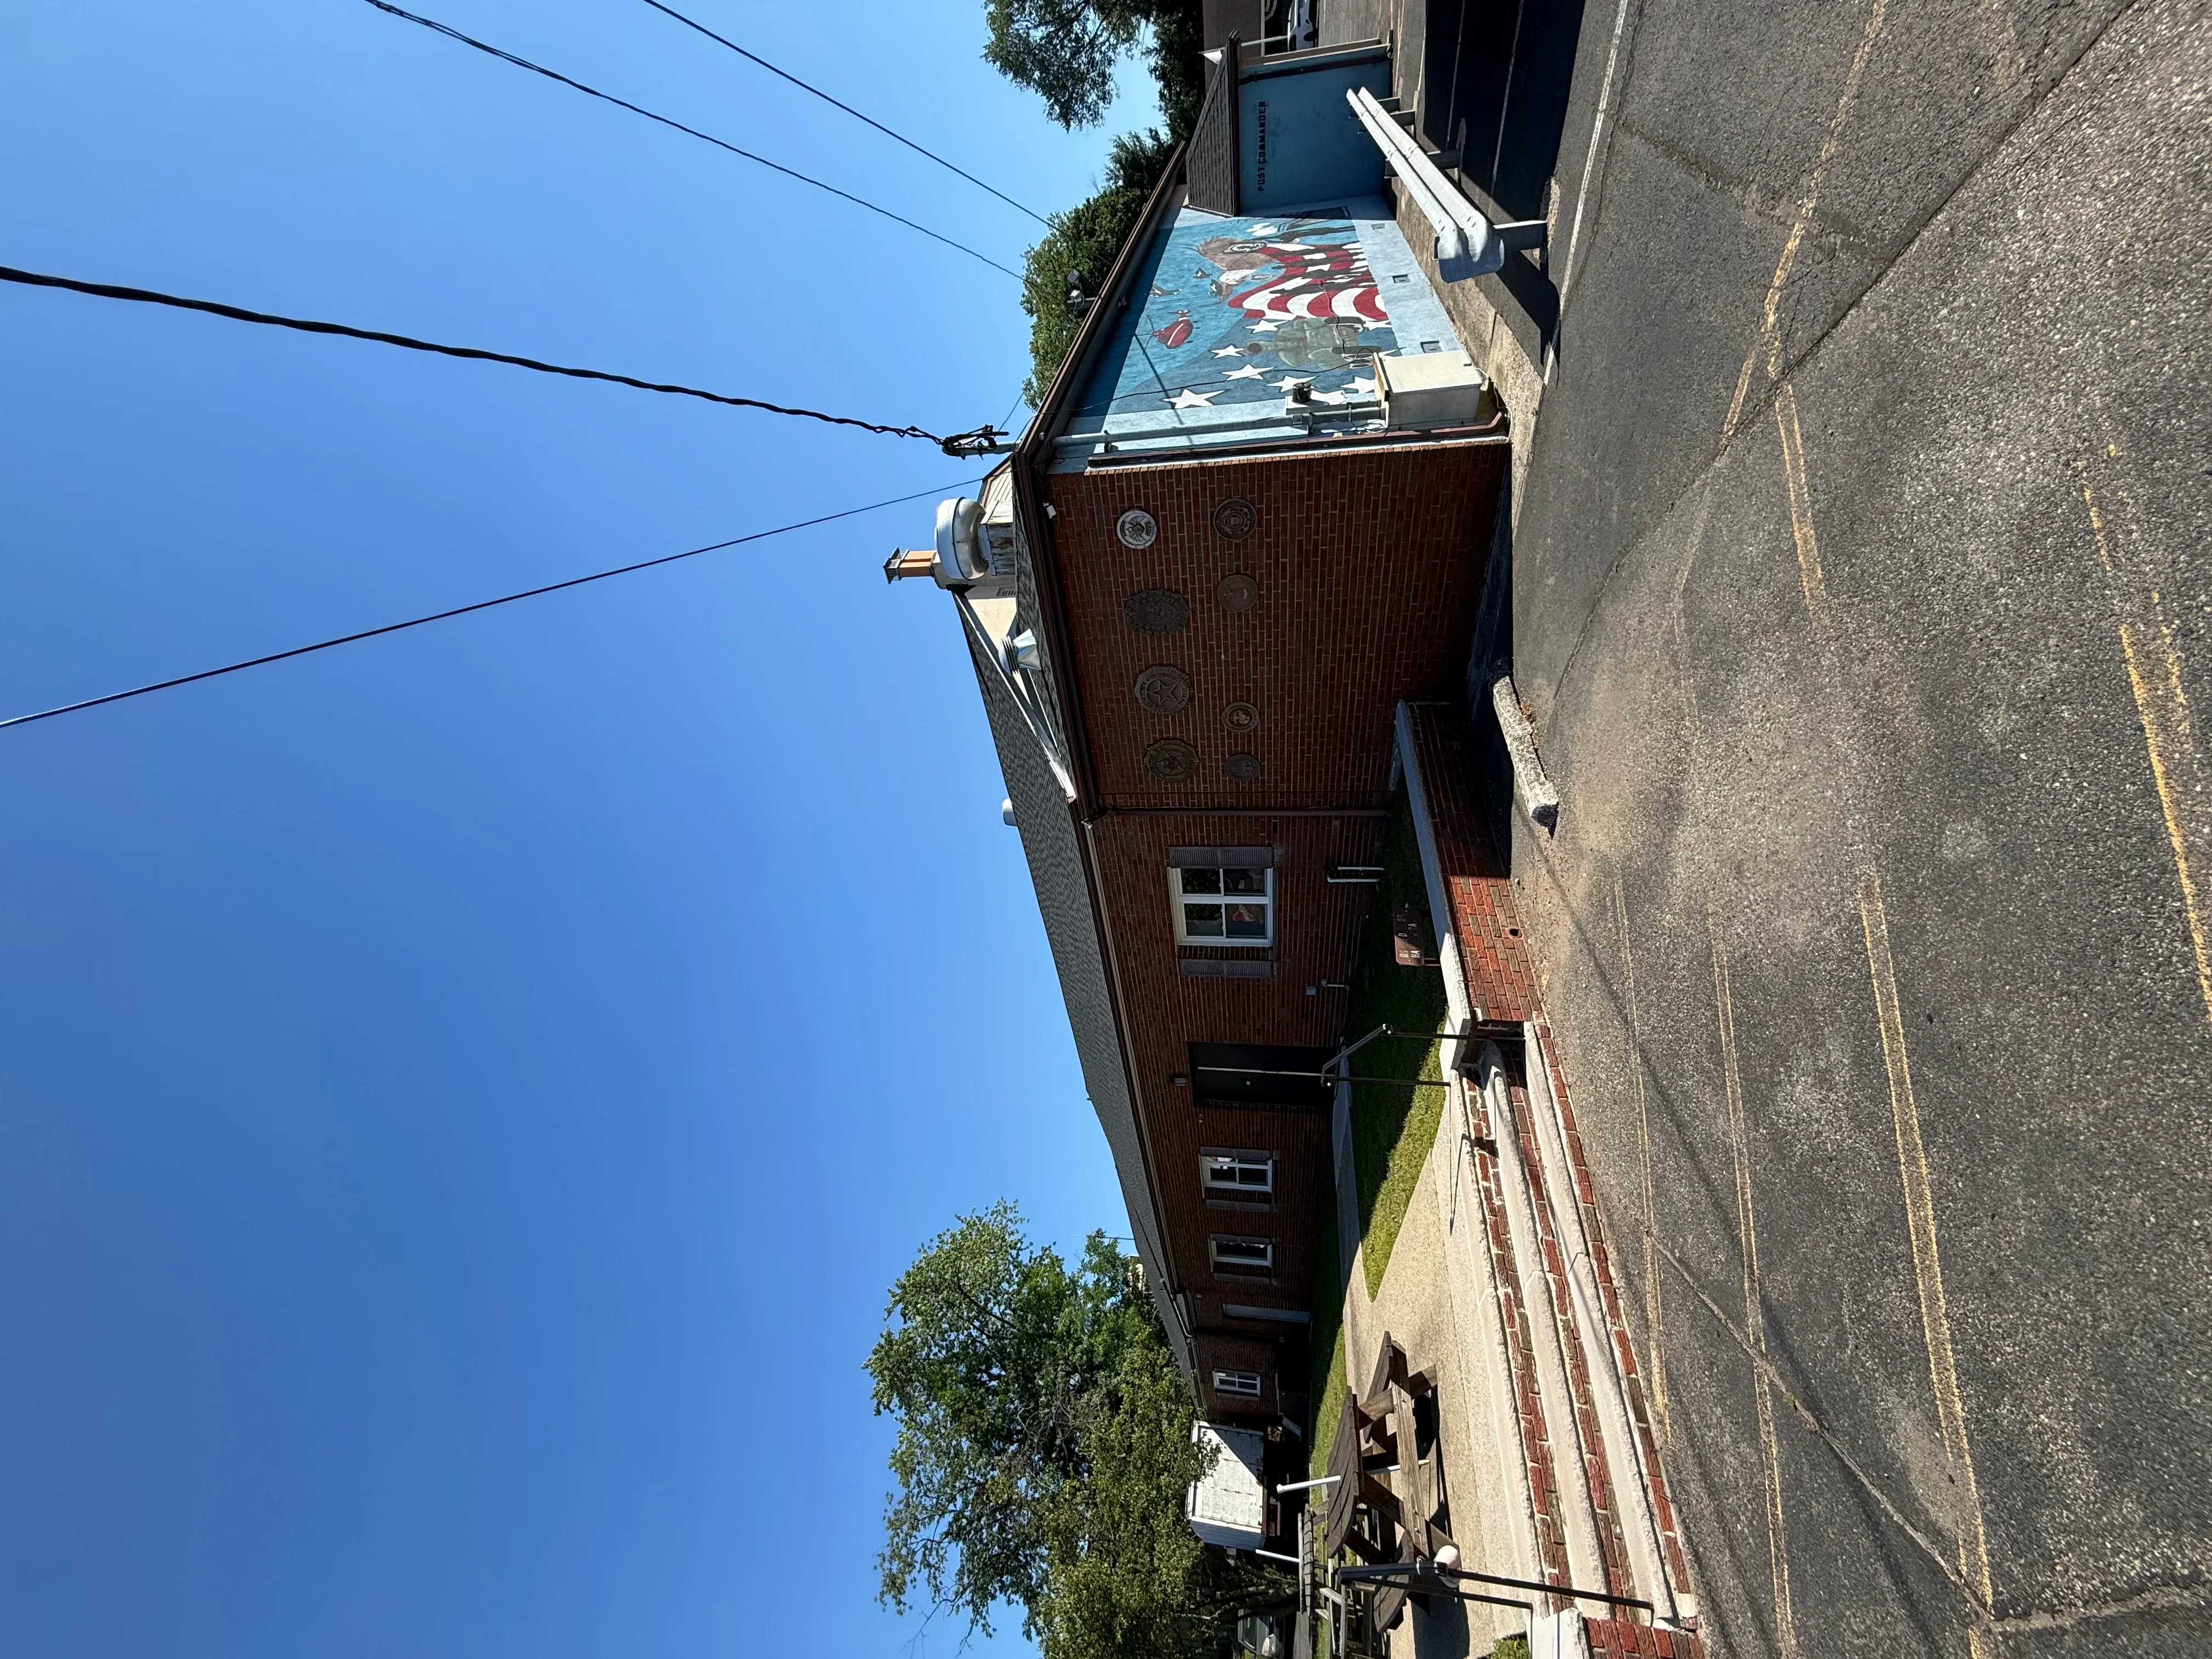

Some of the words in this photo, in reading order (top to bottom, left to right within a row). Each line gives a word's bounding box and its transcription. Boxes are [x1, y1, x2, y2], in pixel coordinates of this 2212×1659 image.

[1257, 100, 1267, 164] COMMANDER
[1257, 166, 1265, 191] POST
[1143, 673, 1164, 687] LEGION
[1140, 689, 1165, 712] AMERICAN
